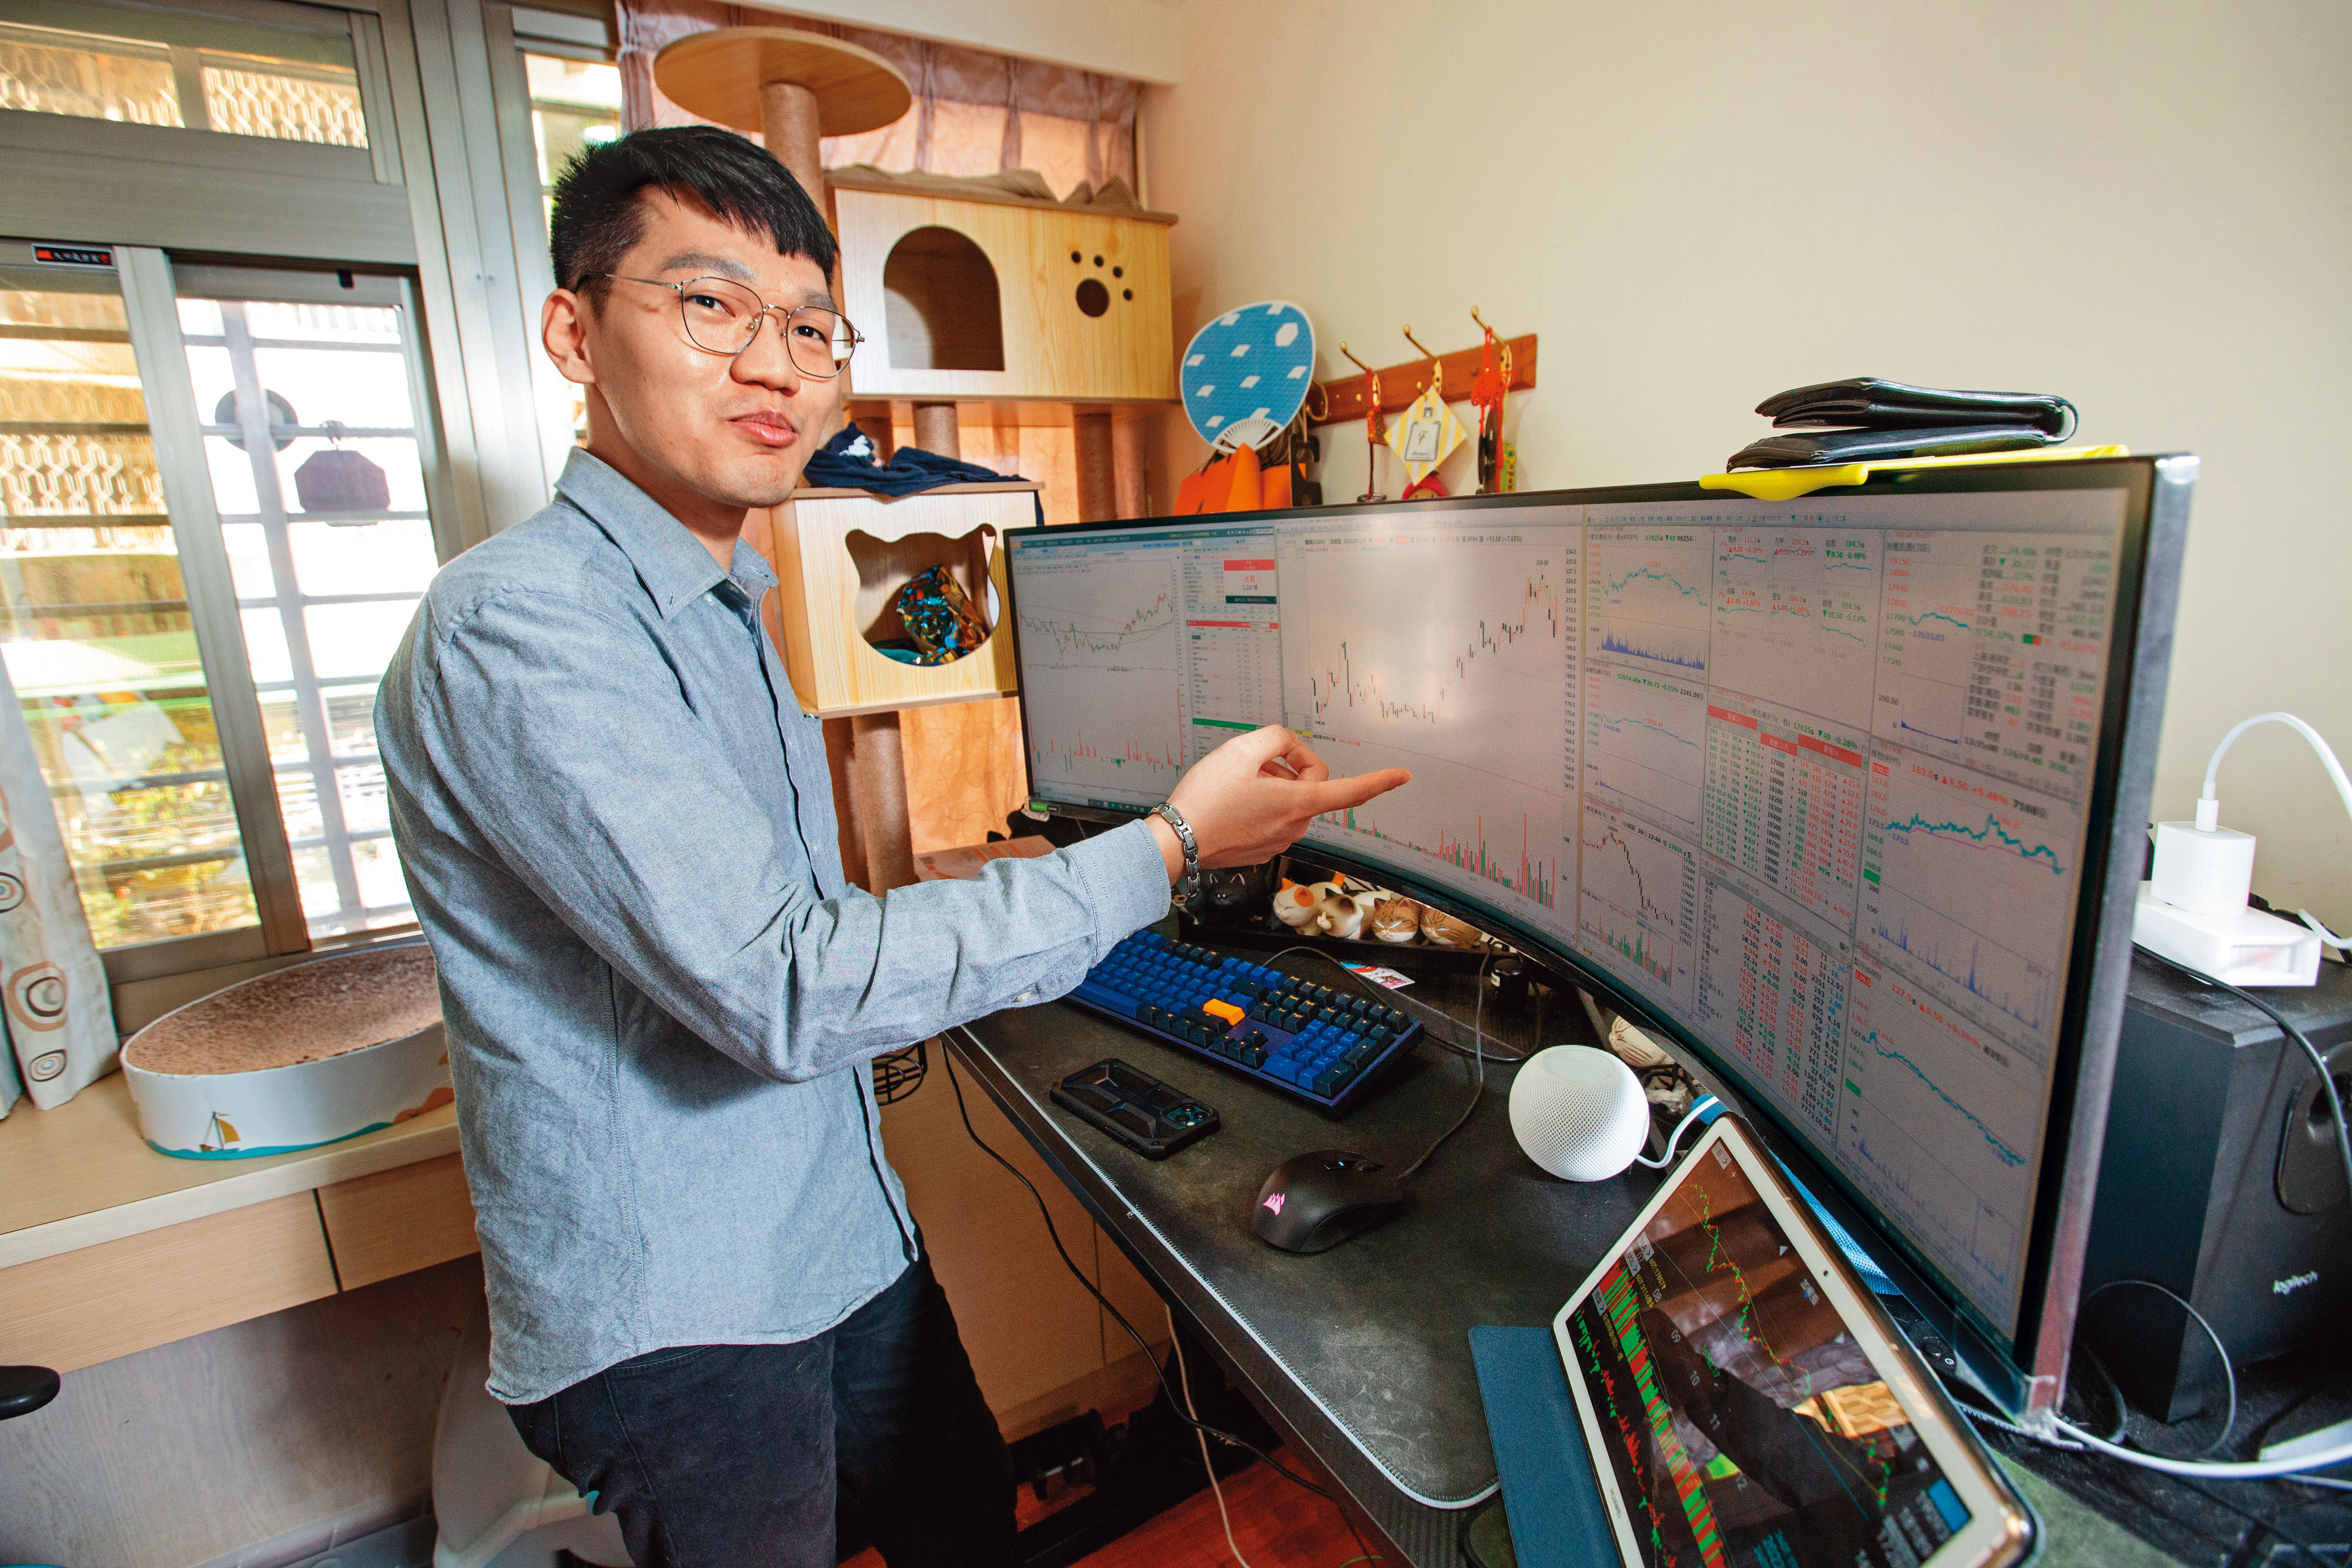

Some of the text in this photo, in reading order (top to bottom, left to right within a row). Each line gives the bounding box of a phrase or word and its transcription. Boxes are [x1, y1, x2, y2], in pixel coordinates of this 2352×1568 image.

[1771, 759, 1784, 768] 17800
[1771, 768, 1784, 777] 17900
[1770, 777, 1784, 786] 18000
[1798, 788, 1807, 796] 510
[1770, 786, 1783, 795] 18100
[1769, 794, 1782, 804] 18200
[1768, 803, 1782, 813] 18300
[1768, 812, 1781, 822] 18400
[1767, 821, 1781, 831] 18500
[1767, 829, 1780, 840] 18600
[1766, 838, 1780, 849] 18700
[1766, 847, 1779, 858] 18800
[1766, 855, 1779, 866] 18900
[1765, 864, 1778, 875] 19000
[1764, 873, 1777, 884] 19100
[1770, 937, 1781, 948] 0.00
[1795, 954, 1807, 966] 0.00
[1821, 952, 1827, 961] 71
[1769, 954, 1780, 965] 0.00
[1794, 971, 1806, 983] 0.00
[1768, 970, 1779, 981] 0.00
